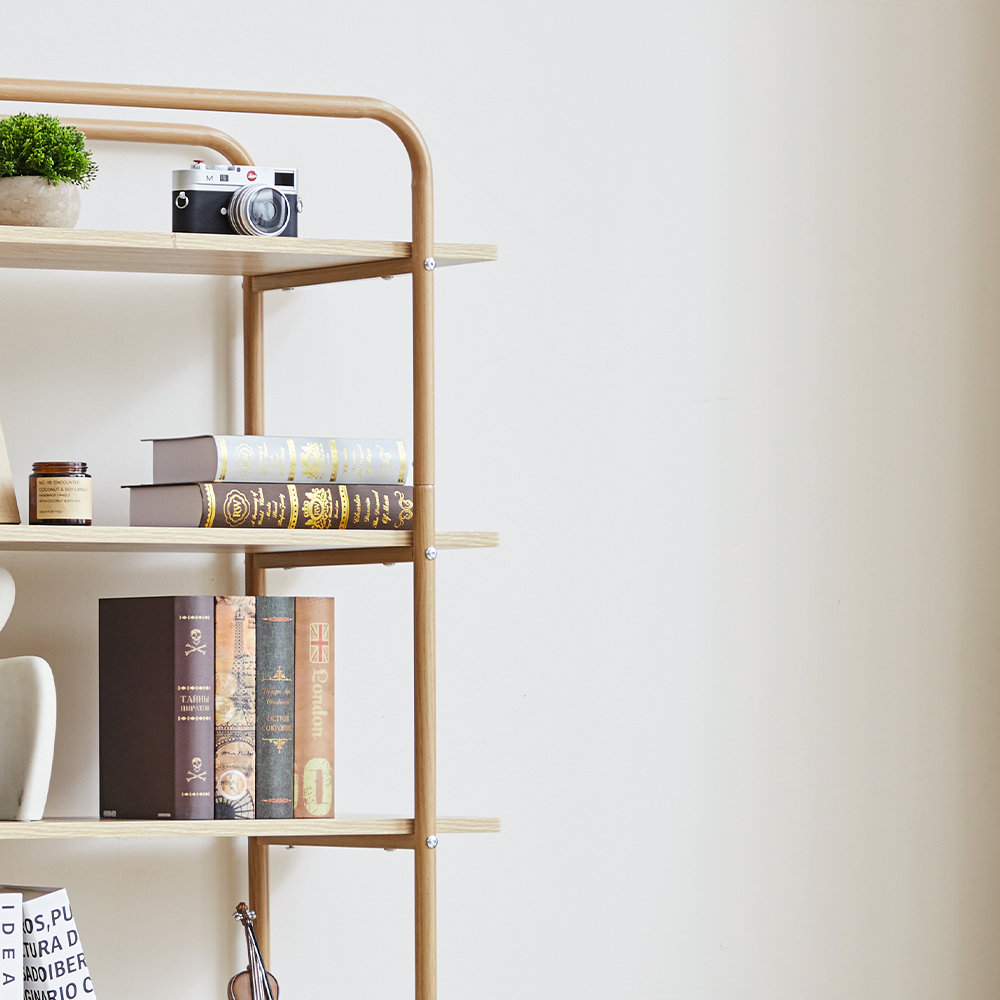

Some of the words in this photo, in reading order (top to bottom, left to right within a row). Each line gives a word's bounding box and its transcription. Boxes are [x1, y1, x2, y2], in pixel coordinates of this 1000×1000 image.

[233, 499, 242, 517] RW
[353, 494, 361, 524] Charles
[382, 495, 390, 515] Man
[180, 694, 209, 703] ТАЙНЫ
[311, 668, 328, 740] London
[23, 935, 63, 958] TURA
[67, 929, 78, 947] D
[83, 976, 94, 993] C
